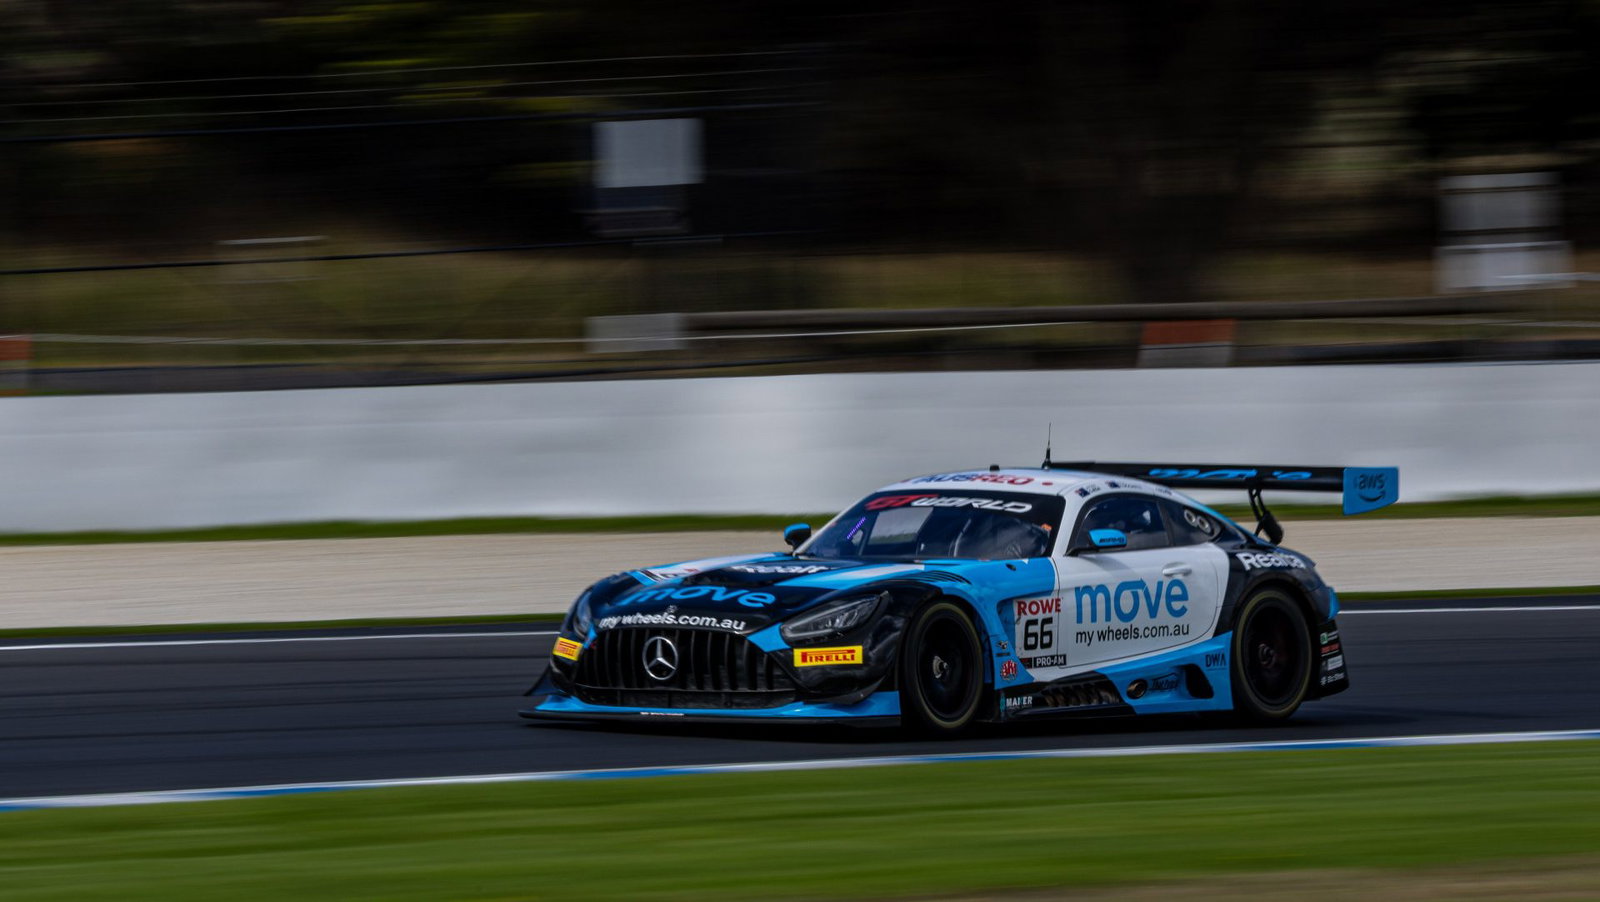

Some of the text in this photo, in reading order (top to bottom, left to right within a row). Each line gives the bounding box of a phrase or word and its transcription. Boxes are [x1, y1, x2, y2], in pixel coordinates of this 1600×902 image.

[613, 585, 776, 608] move
[1017, 598, 1061, 616] ROWE
[1074, 579, 1189, 624] move
[1023, 617, 1053, 651] 66
[1075, 624, 1190, 647] my wheels.com.au
[800, 649, 856, 664] PIRELLI
[1036, 656, 1065, 667] PRO-AM
